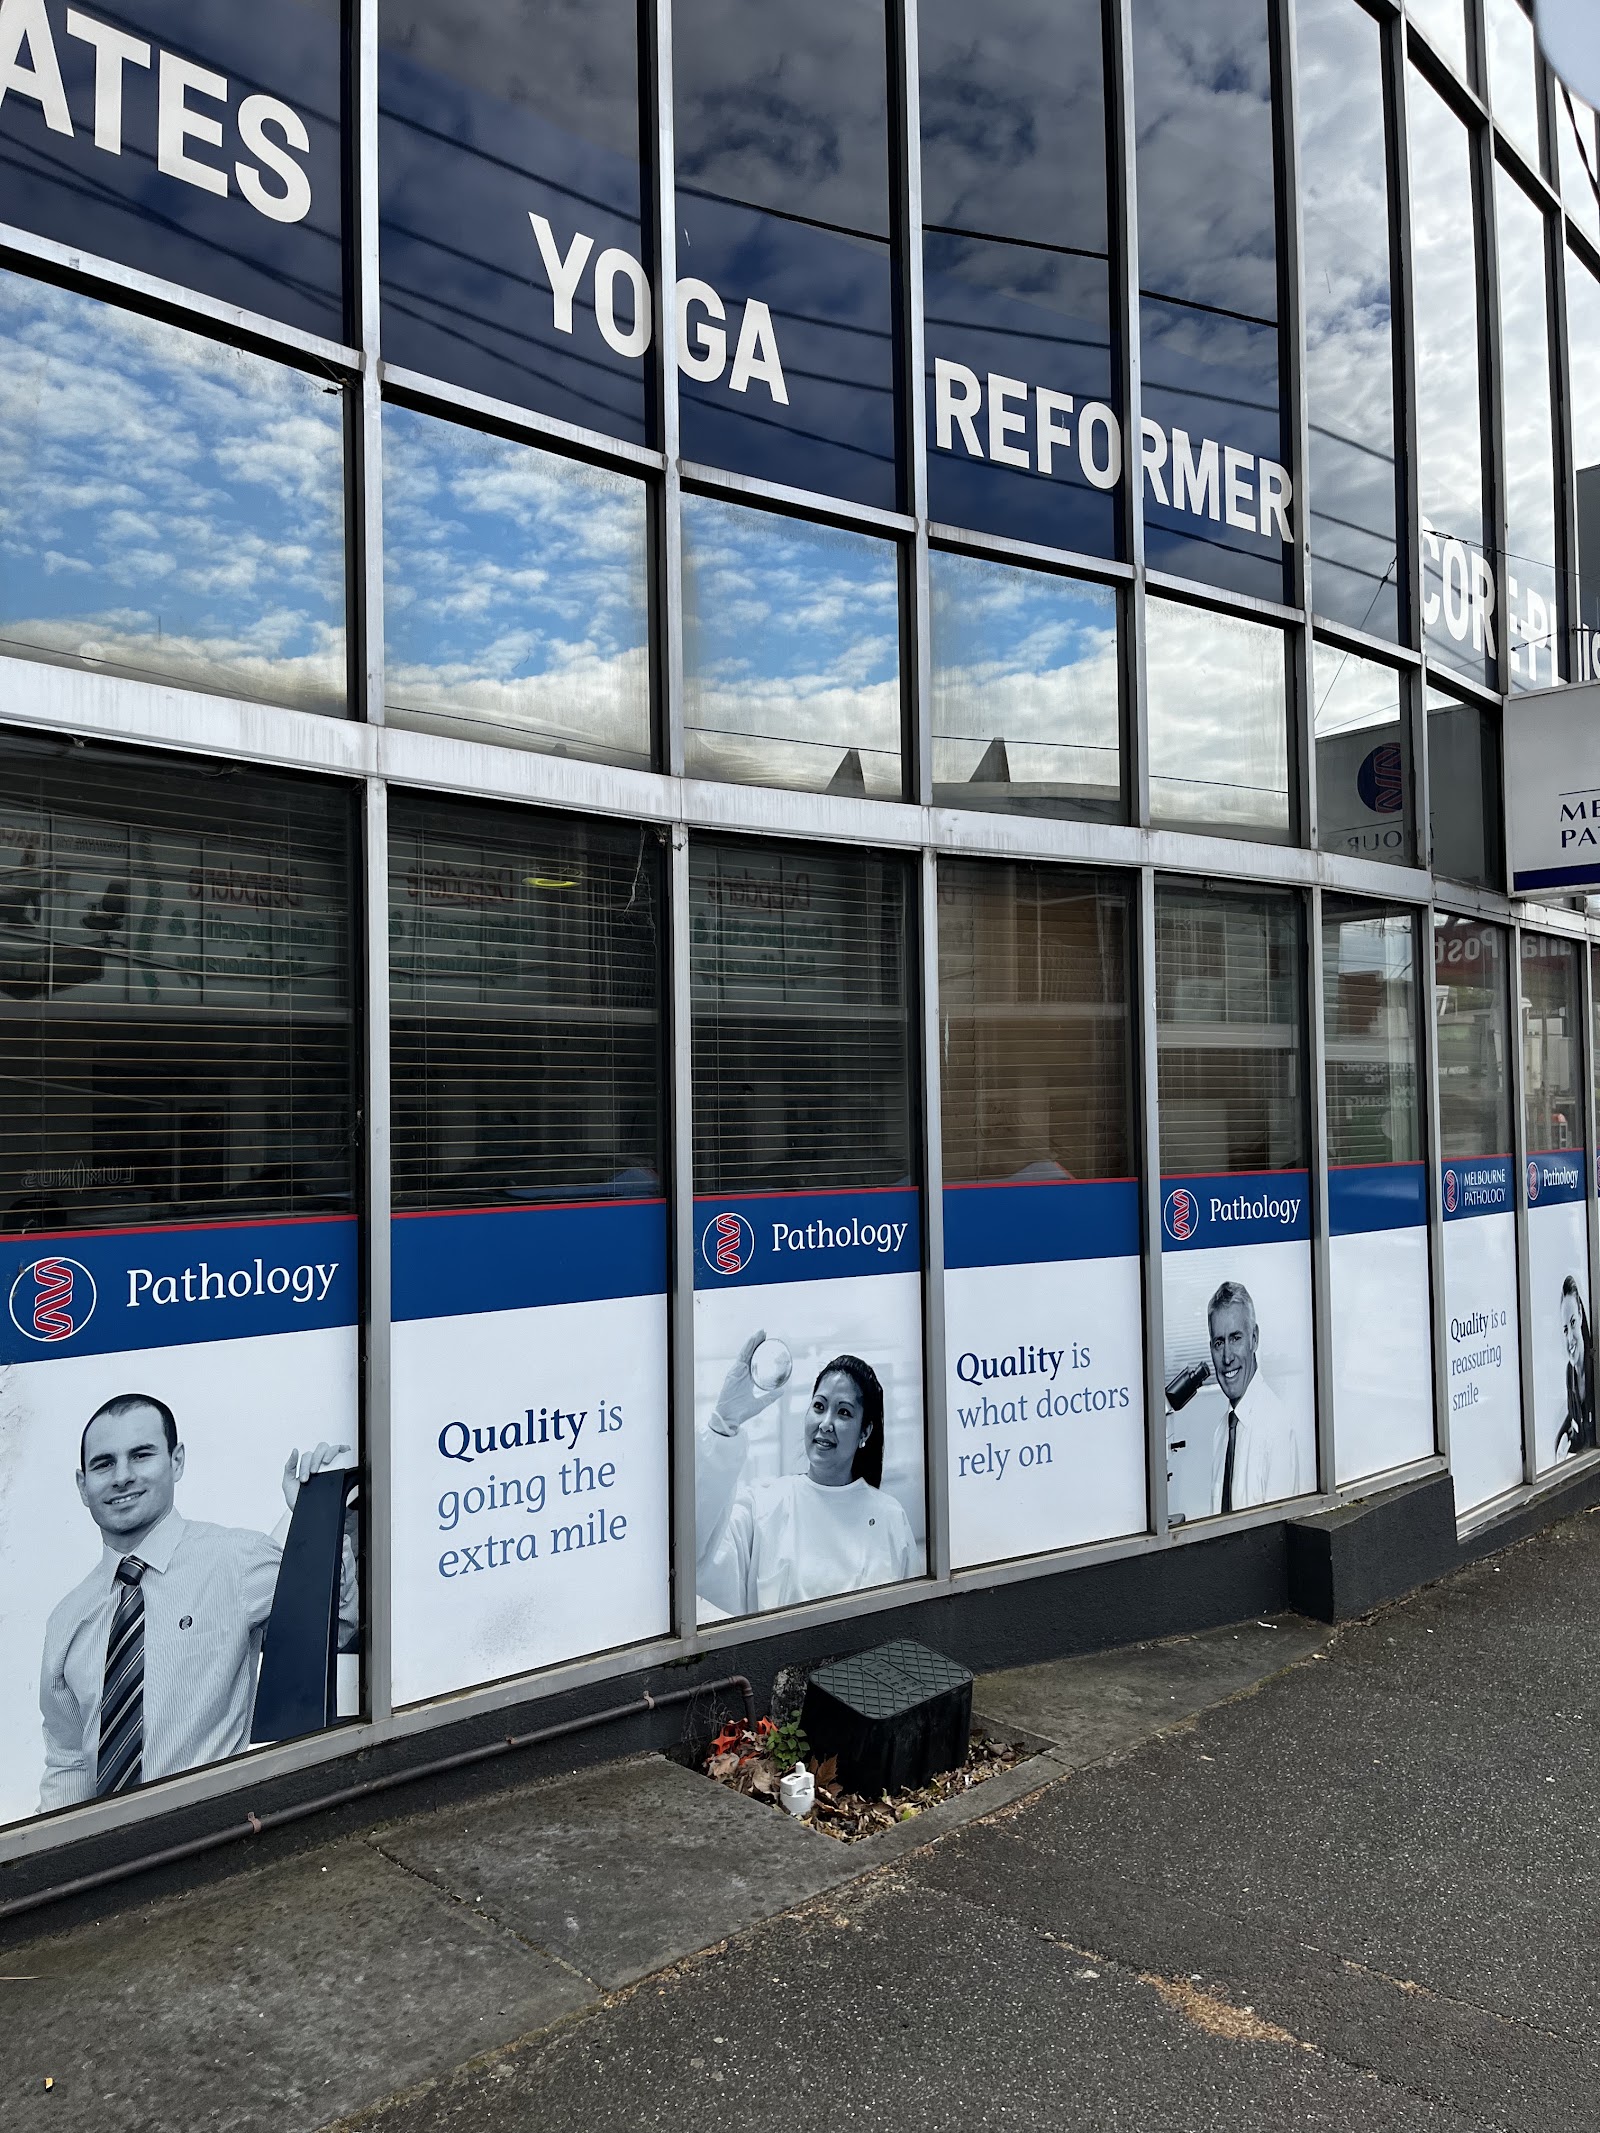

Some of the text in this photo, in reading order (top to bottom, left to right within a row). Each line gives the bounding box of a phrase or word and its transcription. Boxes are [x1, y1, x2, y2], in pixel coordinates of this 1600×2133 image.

[0, 0, 311, 223] ATES
[528, 211, 789, 405] YOGA
[935, 357, 1294, 543] REFORMER
[1561, 826, 1600, 848] PA
[1464, 1168, 1506, 1186] MELBOURNE
[1464, 1187, 1506, 1206] PATHOLOGY
[1543, 1167, 1579, 1189] Pathology
[1209, 1195, 1301, 1224] Pathology
[772, 1217, 908, 1252] Pathology
[127, 1259, 339, 1307] Pathology
[1450, 1308, 1507, 1342] Quality is a
[956, 1342, 1091, 1387] Quality is
[1451, 1343, 1502, 1377] reassuring
[957, 1386, 1130, 1429] what doctors
[1452, 1382, 1479, 1412] smile
[438, 1400, 623, 1463] Quality is
[958, 1442, 1053, 1481] rely on
[438, 1457, 616, 1531] going the
[438, 1508, 627, 1578] extra mile
